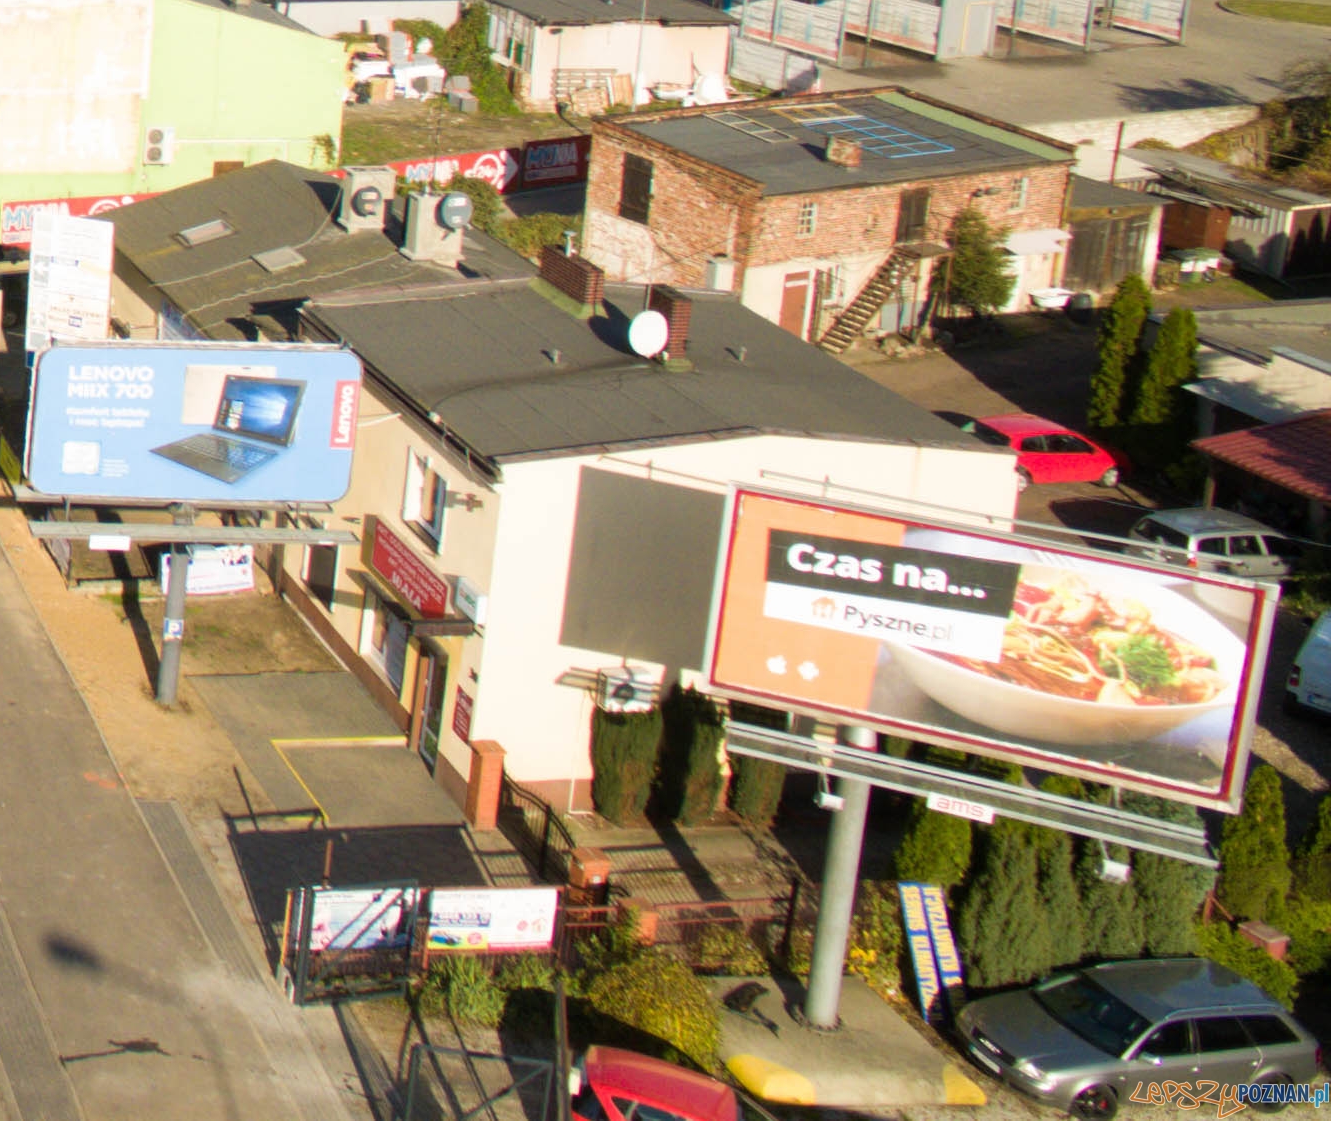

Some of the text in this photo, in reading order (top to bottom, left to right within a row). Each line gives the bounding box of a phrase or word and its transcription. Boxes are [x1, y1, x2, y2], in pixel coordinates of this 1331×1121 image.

[68, 365, 154, 381] LENOVO
[115, 383, 154, 399] 700
[334, 385, 354, 444] Lenovo
[787, 543, 988, 598] Czas na...
[843, 605, 955, 642] Pyszne.pl
[936, 797, 984, 817] ams
